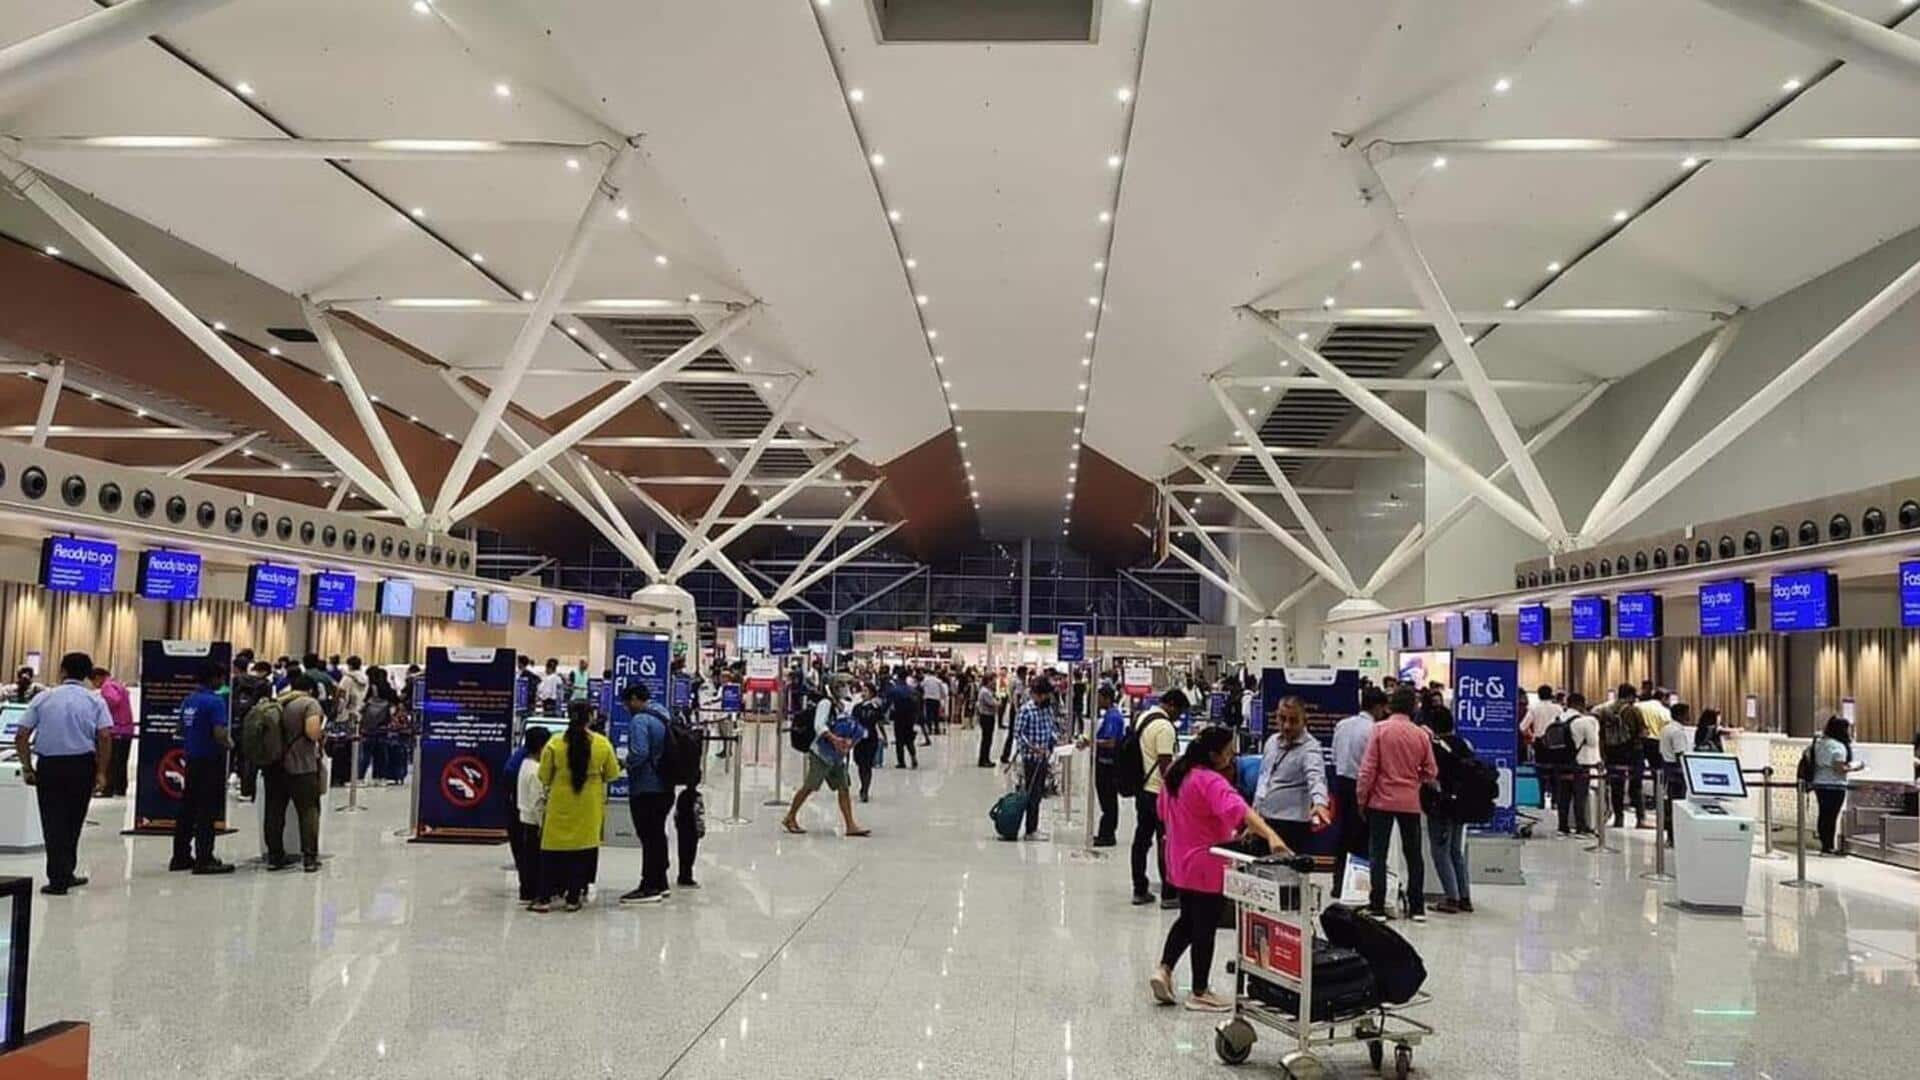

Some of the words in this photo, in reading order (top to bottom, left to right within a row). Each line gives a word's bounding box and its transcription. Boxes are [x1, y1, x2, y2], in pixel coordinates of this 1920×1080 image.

[54, 543, 88, 563] Ready
[88, 550, 98, 561] to
[99, 553, 113, 567] go
[149, 556, 175, 573] Ready
[176, 562, 186, 572] to
[186, 563, 198, 575] go
[1903, 570, 1920, 587] Fas
[1701, 591, 1715, 607] Bag
[1716, 591, 1732, 605] drop
[1773, 584, 1790, 600] Bag
[1791, 583, 1810, 599] drop
[615, 654, 638, 675] Fit
[640, 655, 656, 676] &
[614, 676, 628, 697] fl
[1458, 675, 1484, 697] Fit
[1486, 676, 1504, 698] &
[1458, 699, 1486, 728] fly
